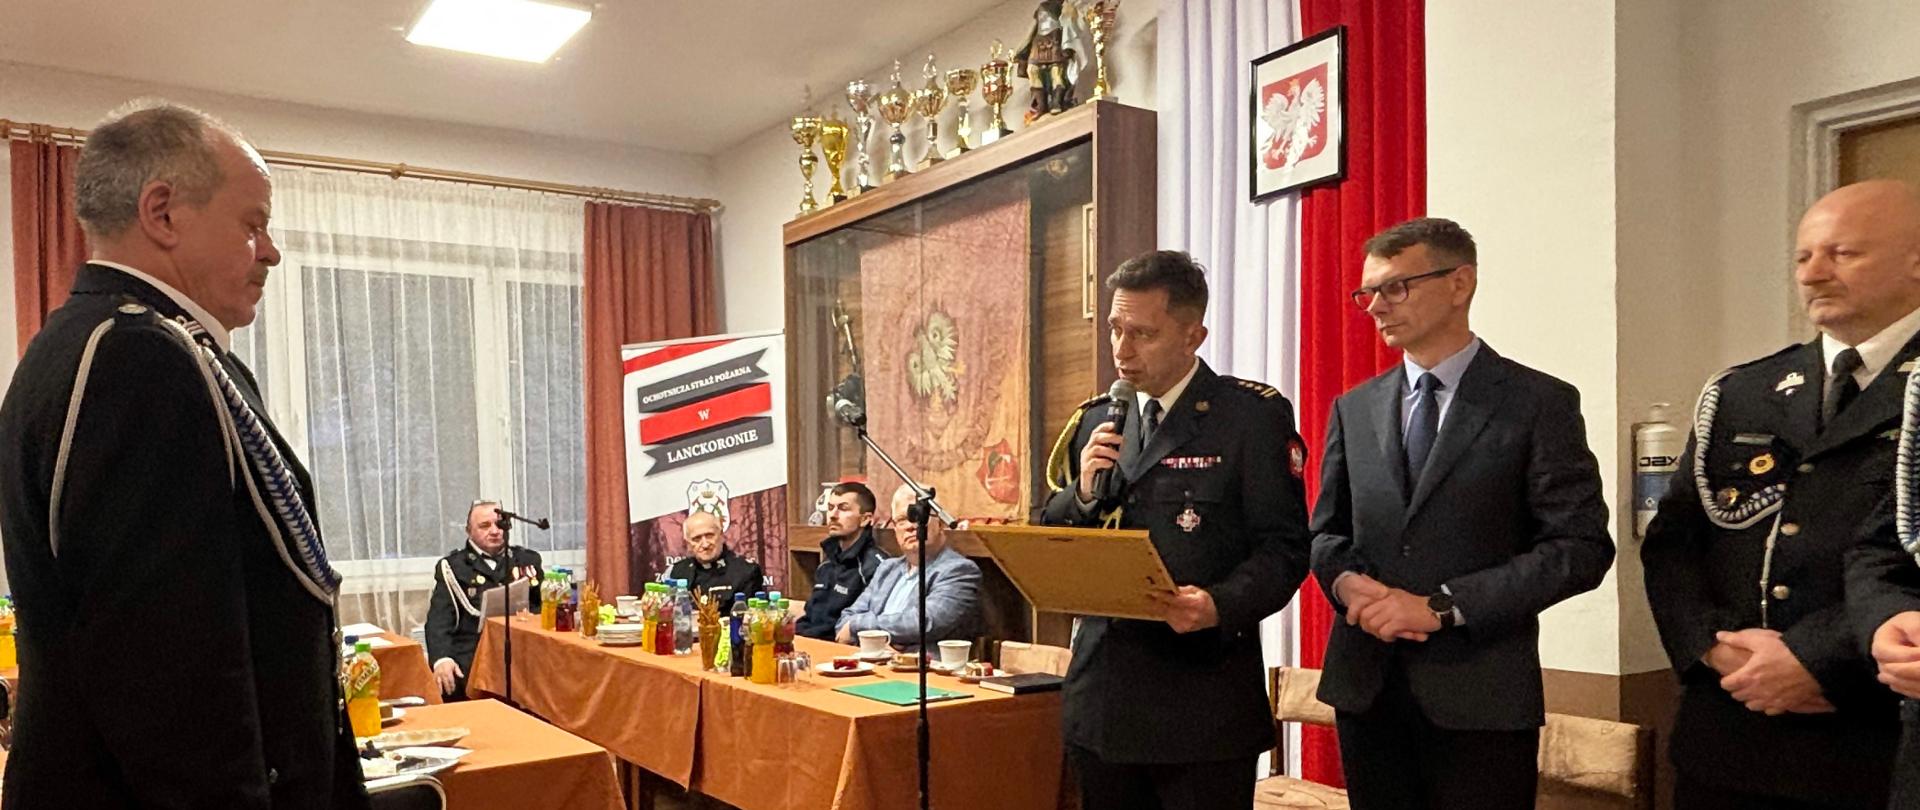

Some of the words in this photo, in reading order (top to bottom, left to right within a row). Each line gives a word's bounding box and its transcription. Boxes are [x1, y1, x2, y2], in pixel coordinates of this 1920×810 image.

[642, 384, 690, 404] OCHOTNICZA
[690, 375, 714, 390] STRAŻ
[715, 366, 752, 383] POŻARNA
[697, 408, 710, 421] W
[667, 429, 758, 463] LANCKORONIE
